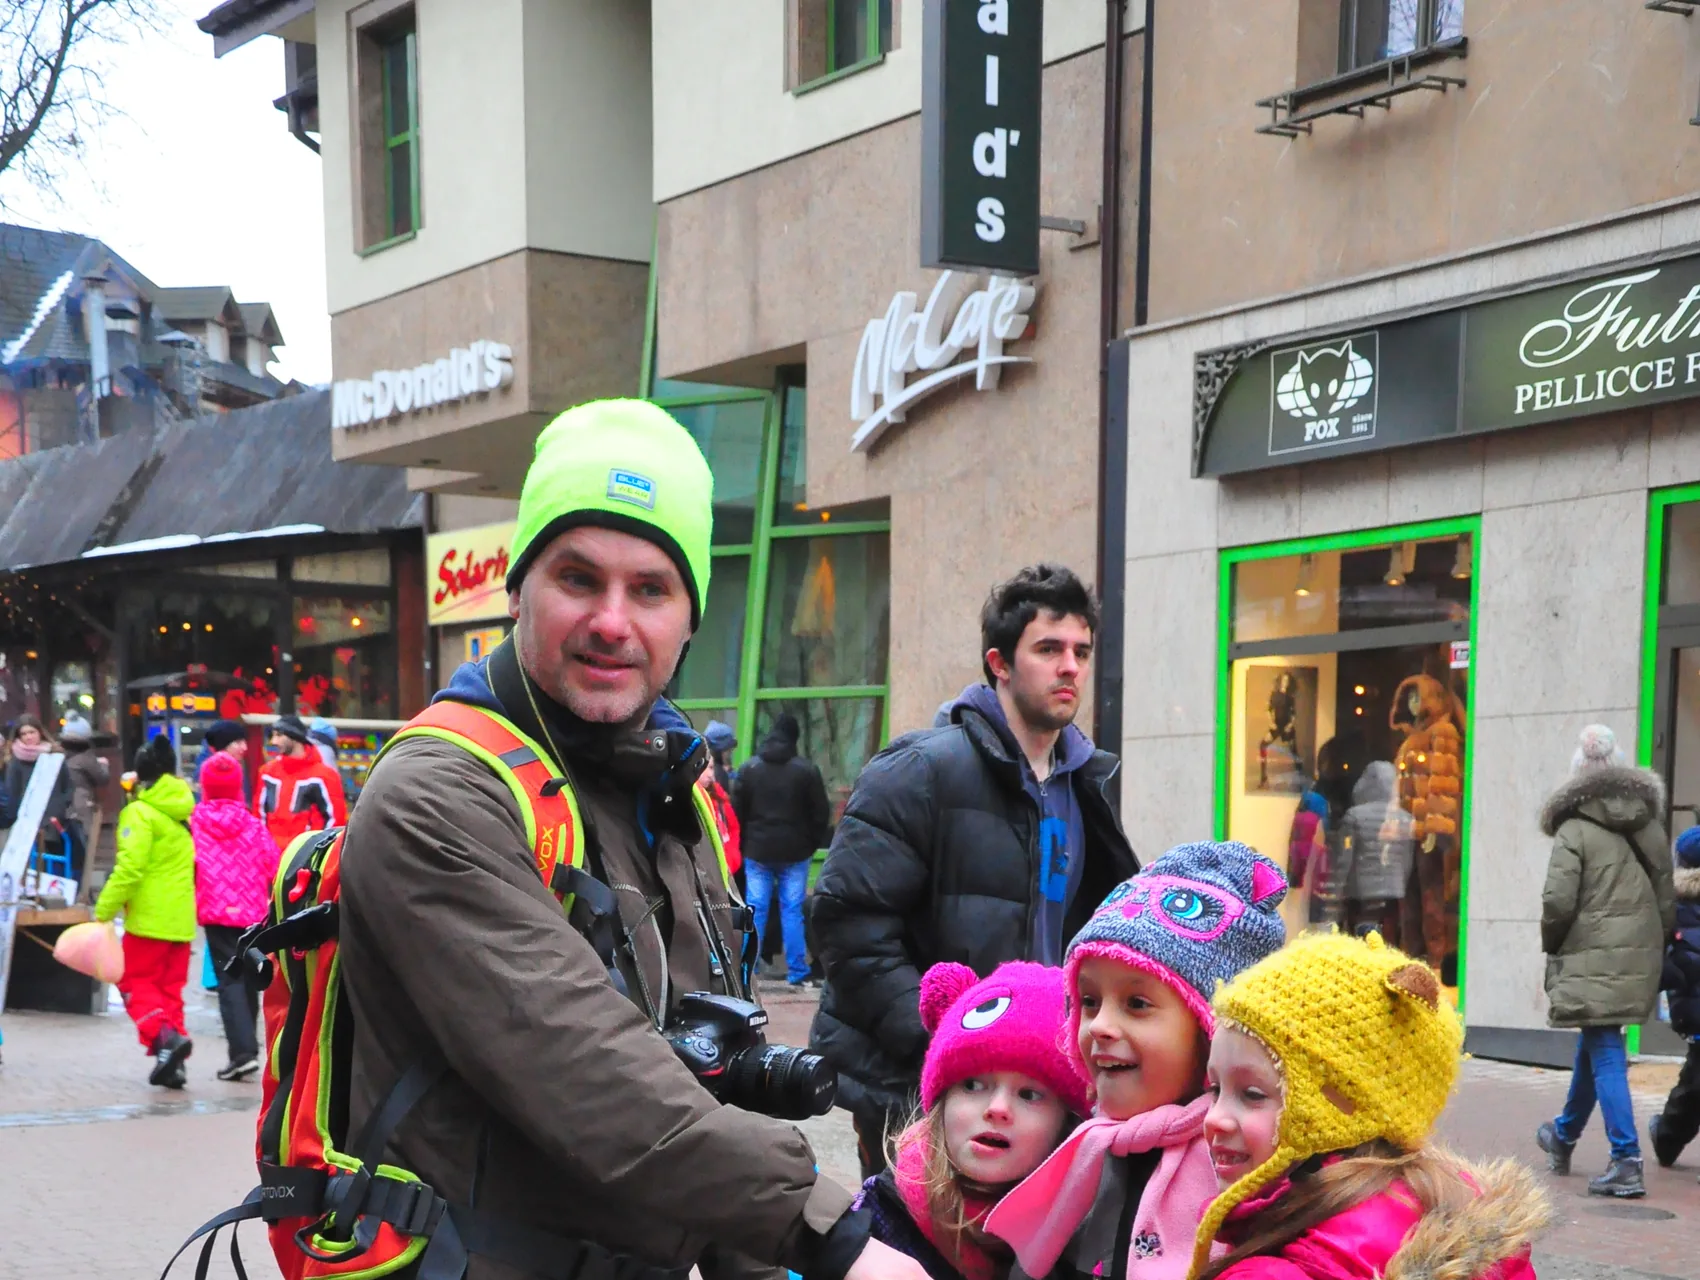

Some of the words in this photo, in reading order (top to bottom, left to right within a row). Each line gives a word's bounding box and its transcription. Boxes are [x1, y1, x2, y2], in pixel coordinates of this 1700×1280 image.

[331, 340, 512, 428] McDonald's
[1513, 356, 1676, 415] PELLICCE
[1303, 416, 1340, 442] FOX
